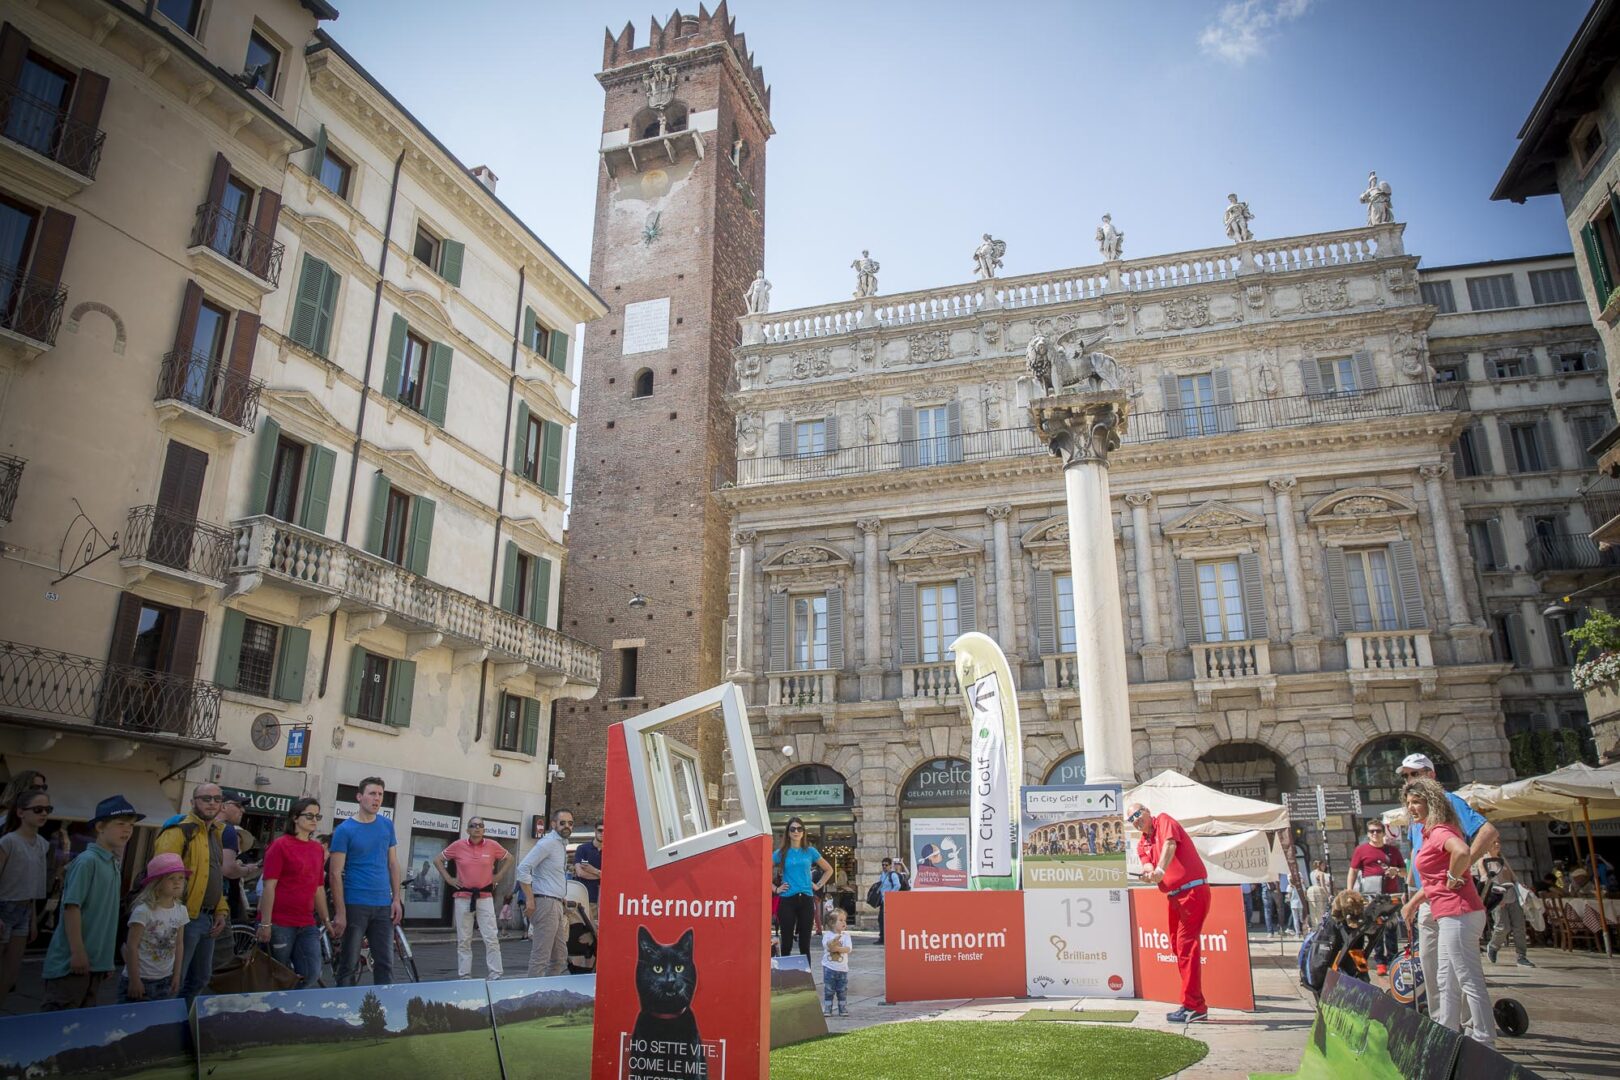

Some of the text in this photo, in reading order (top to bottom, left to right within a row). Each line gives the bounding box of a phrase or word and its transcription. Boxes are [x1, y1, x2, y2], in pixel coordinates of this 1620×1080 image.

[1029, 794, 1079, 803] In City Golf
[978, 757, 996, 869] In City Golf
[412, 818, 449, 829] Deutsche Bank
[1030, 867, 1121, 881] VERONA 2016
[618, 893, 737, 918] Internorm
[1061, 898, 1094, 927] 13
[900, 928, 1007, 950] Internorm
[925, 953, 952, 962] Finestre
[958, 952, 983, 961] Fenster
[650, 1040, 688, 1056] SETTE
[690, 1044, 719, 1059] VITE.
[628, 1056, 708, 1076] COME LE MIE
